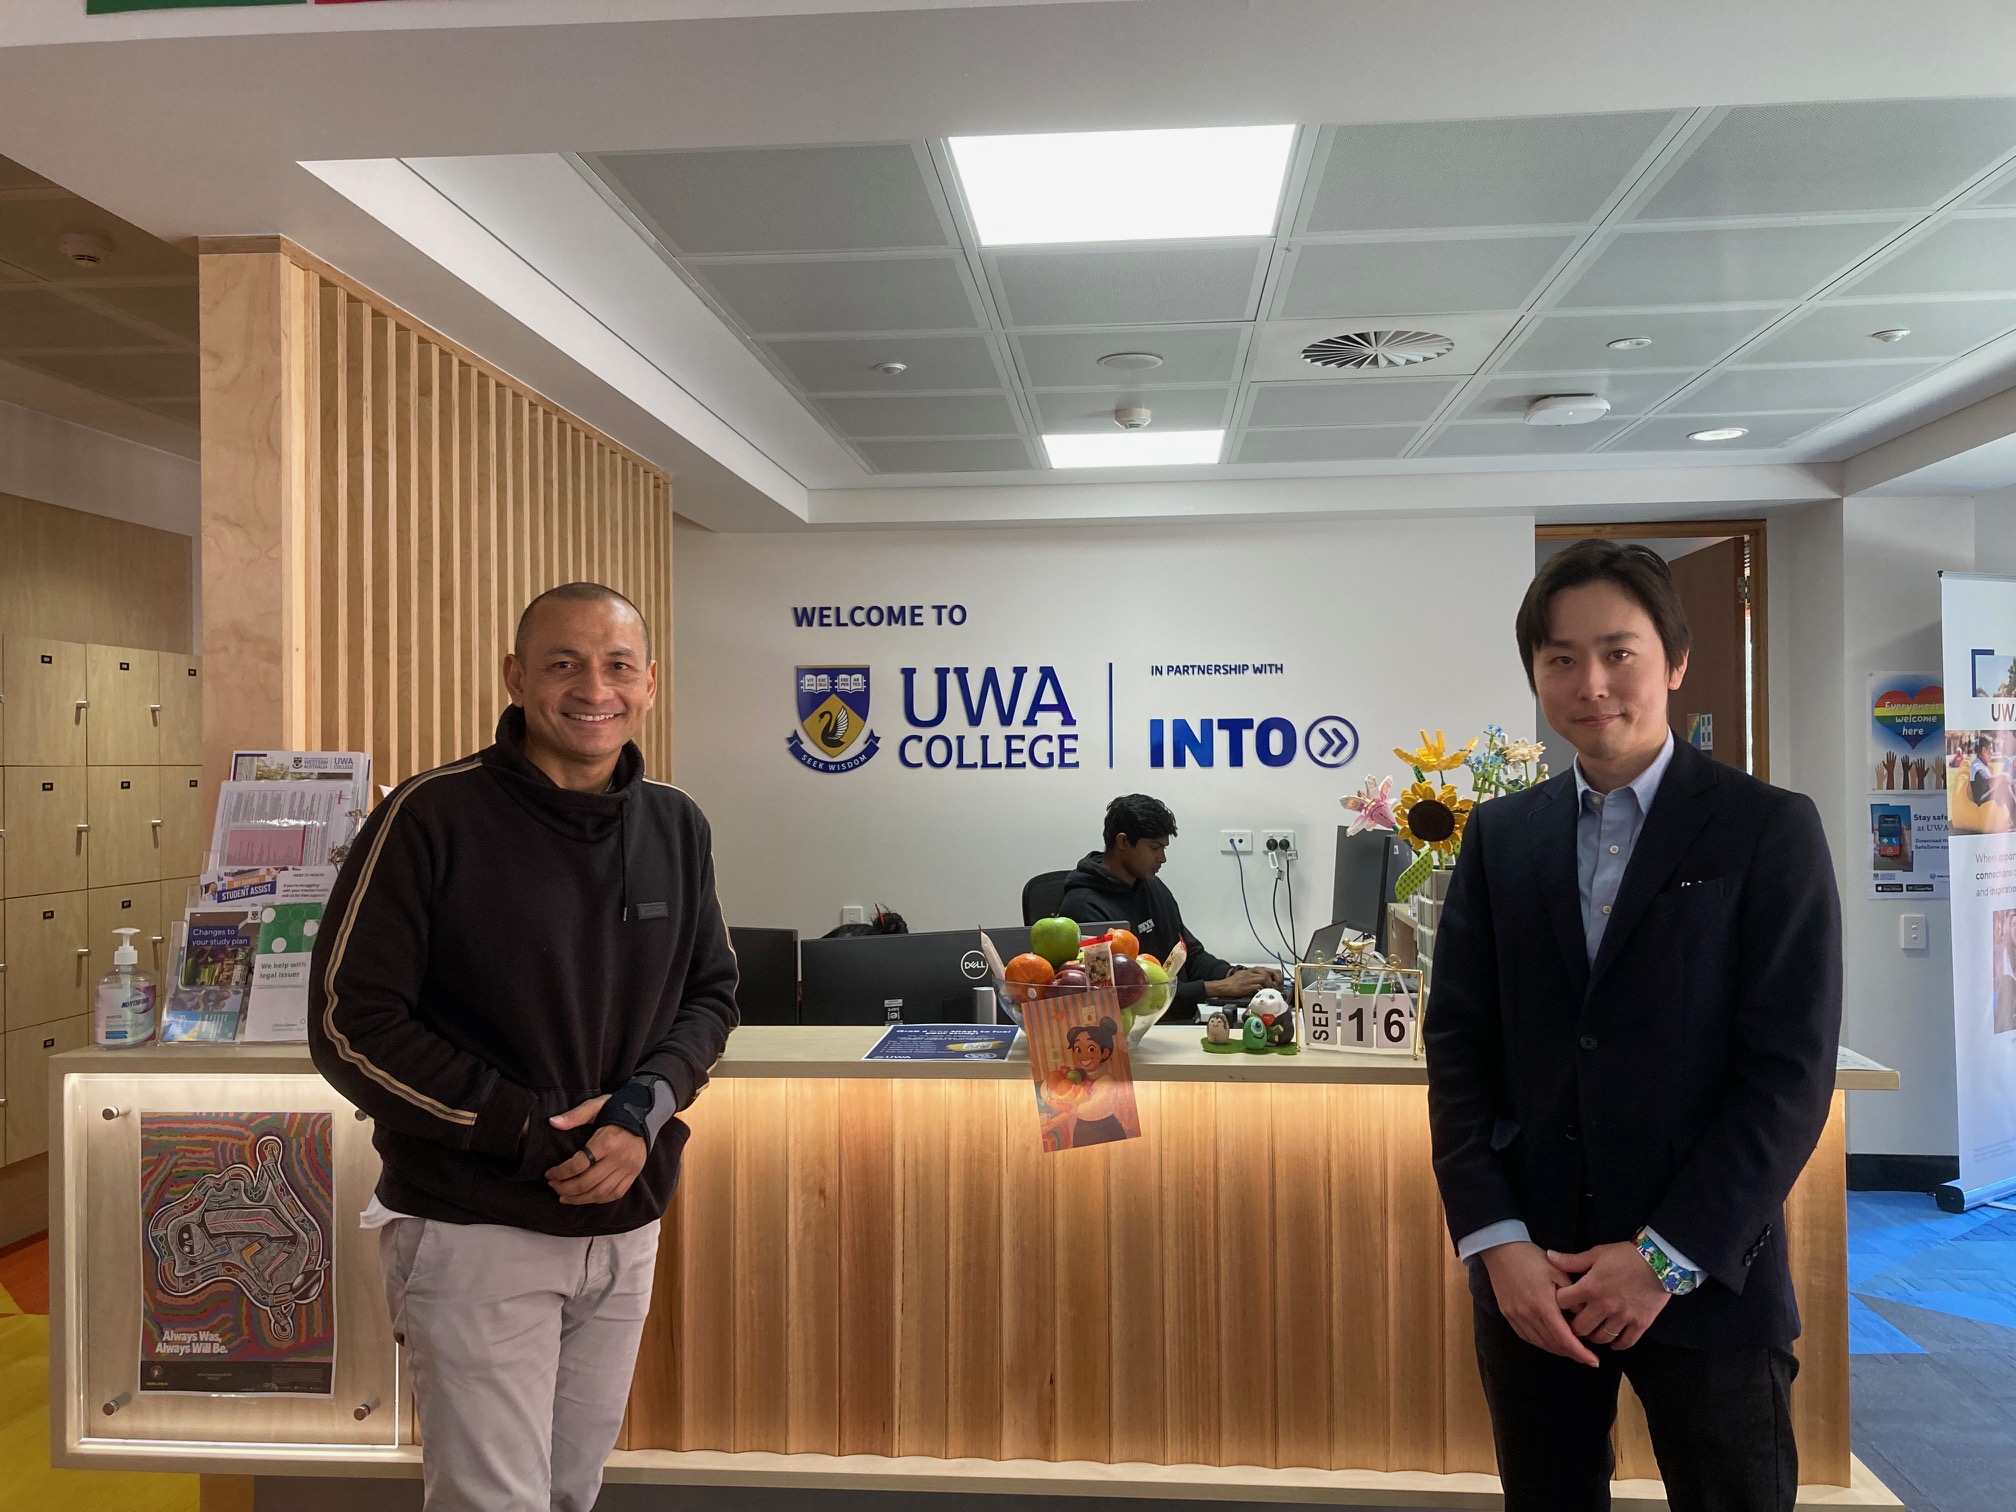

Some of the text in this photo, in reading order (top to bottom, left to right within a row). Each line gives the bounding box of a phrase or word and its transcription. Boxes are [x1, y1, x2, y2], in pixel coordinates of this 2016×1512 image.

[793, 604, 967, 627] WELCOME TO
[1151, 664, 1284, 676] IN PARTNERSHIP WITH
[901, 666, 1077, 727] UWA
[1885, 701, 1941, 713] Everyone is
[1991, 703, 2016, 722] UW
[1895, 714, 1937, 723] welcome
[1902, 726, 1924, 736] here
[1150, 717, 1297, 768] INTO
[899, 734, 1080, 769] COLLEGE
[334, 757, 354, 765] UWA
[801, 754, 867, 771] SEEK WISDOM
[1913, 814, 1932, 822] Stay
[1975, 853, 1997, 863] Where
[1976, 870, 2013, 880] connections
[222, 884, 272, 900] STUDENT ASSIST
[1976, 887, 1989, 897] and
[193, 928, 226, 939] Changes
[192, 938, 248, 947] your study plan
[274, 962, 289, 970] help
[964, 961, 986, 969] DELL
[260, 972, 277, 980] legal
[1312, 1003, 1329, 1041] SEP
[1348, 1008, 1405, 1043] 1 6
[163, 1330, 222, 1343] Always Was,
[155, 1342, 229, 1356] Always Will Be.
